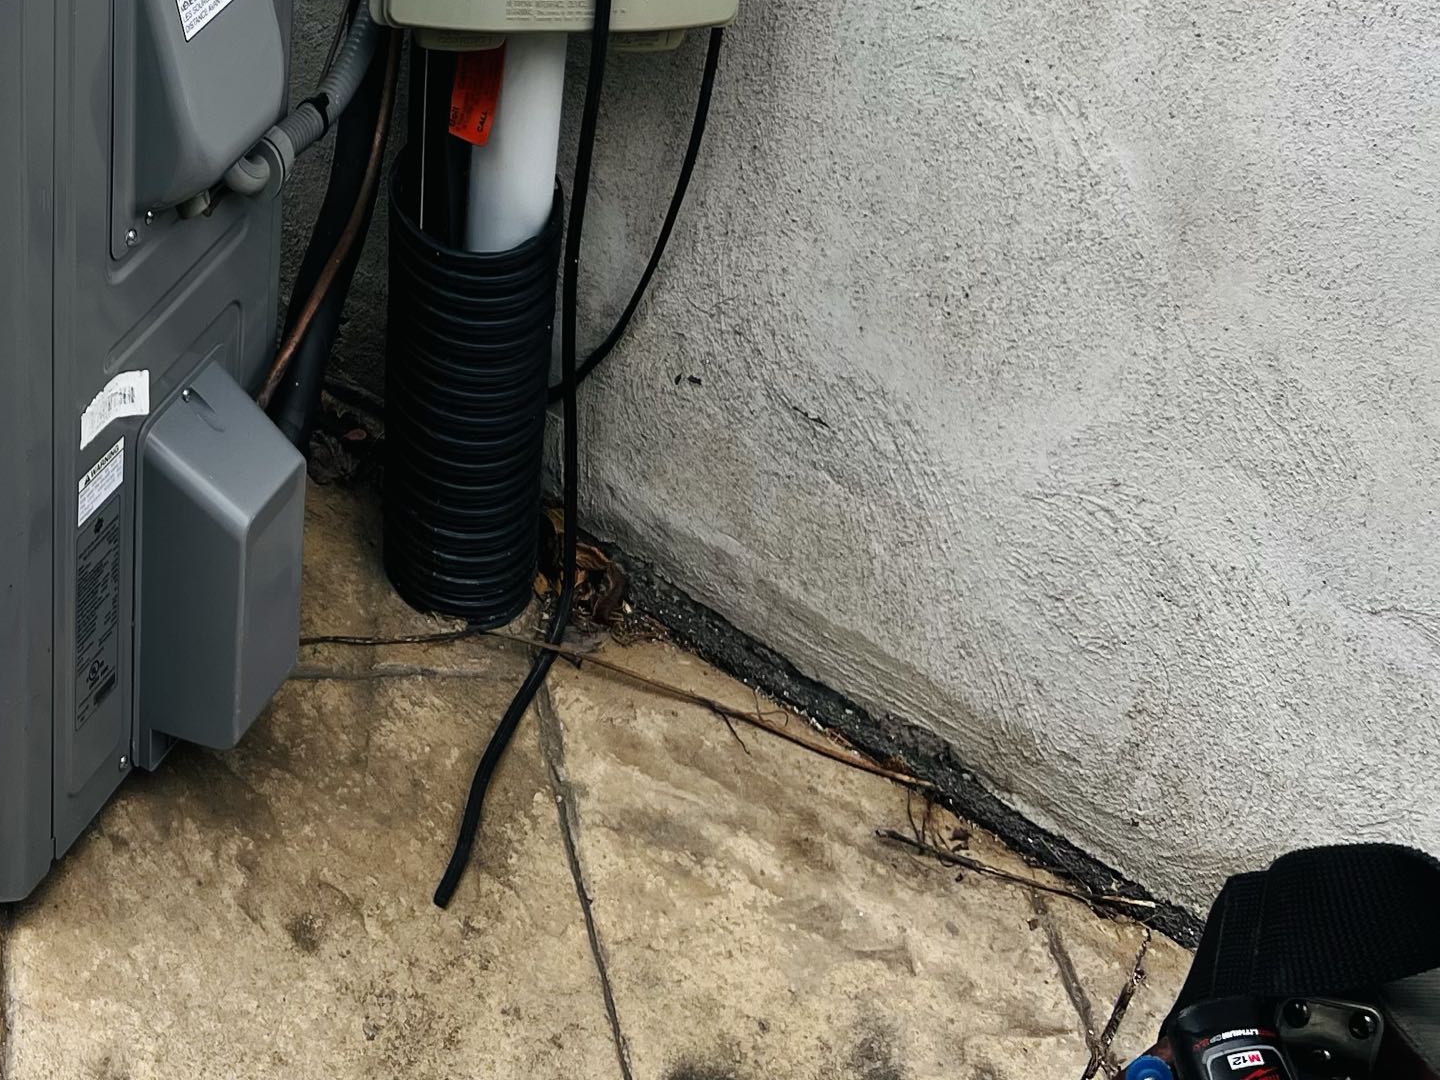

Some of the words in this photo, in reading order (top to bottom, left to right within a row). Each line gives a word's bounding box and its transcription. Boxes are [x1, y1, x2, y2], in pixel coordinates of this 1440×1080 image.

[185, 8, 207, 33] DISTANCE
[476, 110, 488, 133] CALL
[91, 445, 120, 478] WARNING
[1232, 1053, 1261, 1066] M12
